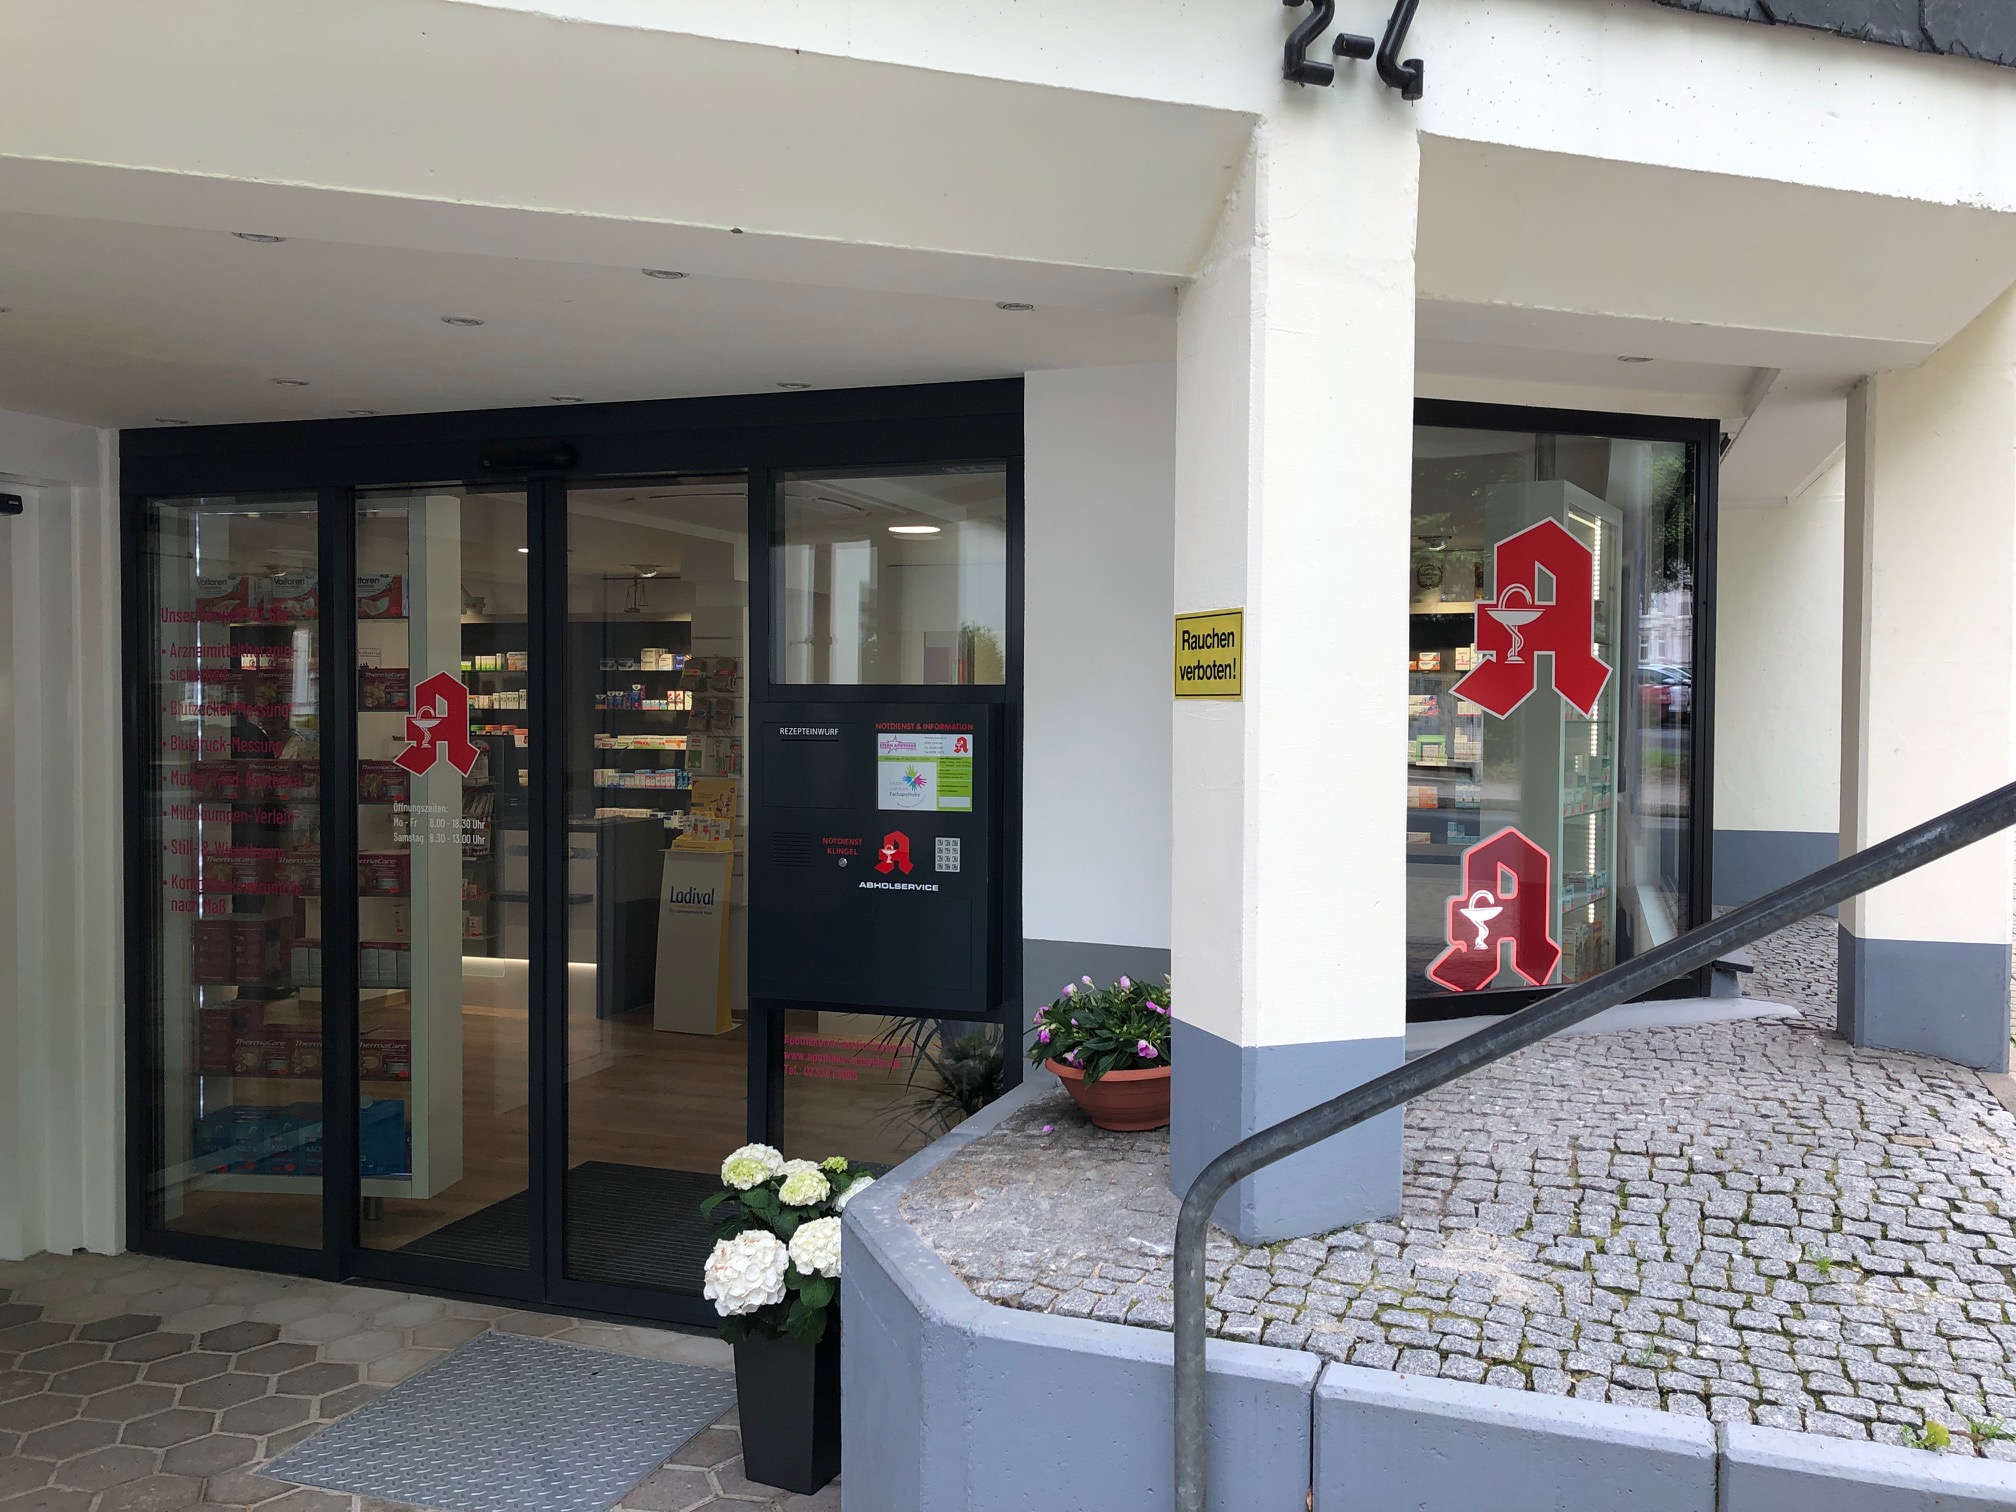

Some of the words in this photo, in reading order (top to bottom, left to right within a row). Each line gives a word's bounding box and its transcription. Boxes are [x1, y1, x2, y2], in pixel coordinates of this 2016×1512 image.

[273, 577, 305, 586] Voltaren
[161, 608, 195, 623] Unser
[1182, 627, 1235, 650] Rauchen
[1179, 657, 1236, 681] verboten!
[779, 727, 839, 736] REZEPTEINWURF
[875, 722, 915, 730] NOTDIENST
[923, 723, 974, 731] INFORMATION
[393, 800, 448, 814] Öffnungszeiten:
[393, 817, 403, 827] Mo
[410, 818, 418, 828] Fr
[429, 818, 445, 828] 8.00
[452, 819, 471, 829] 18.30
[472, 819, 485, 830] Uhr
[393, 832, 424, 845] Samstag
[429, 834, 445, 844] 8.30
[452, 834, 471, 844] 13.00
[472, 835, 485, 845] Uhr
[822, 837, 863, 846] NOTDIENST
[827, 847, 858, 856] KLINGEL
[206, 856, 256, 864] ThermaCare
[859, 881, 939, 892] ABHOLSERVICE
[670, 886, 714, 905] Ladival
[235, 1038, 286, 1047] ThermaCare
